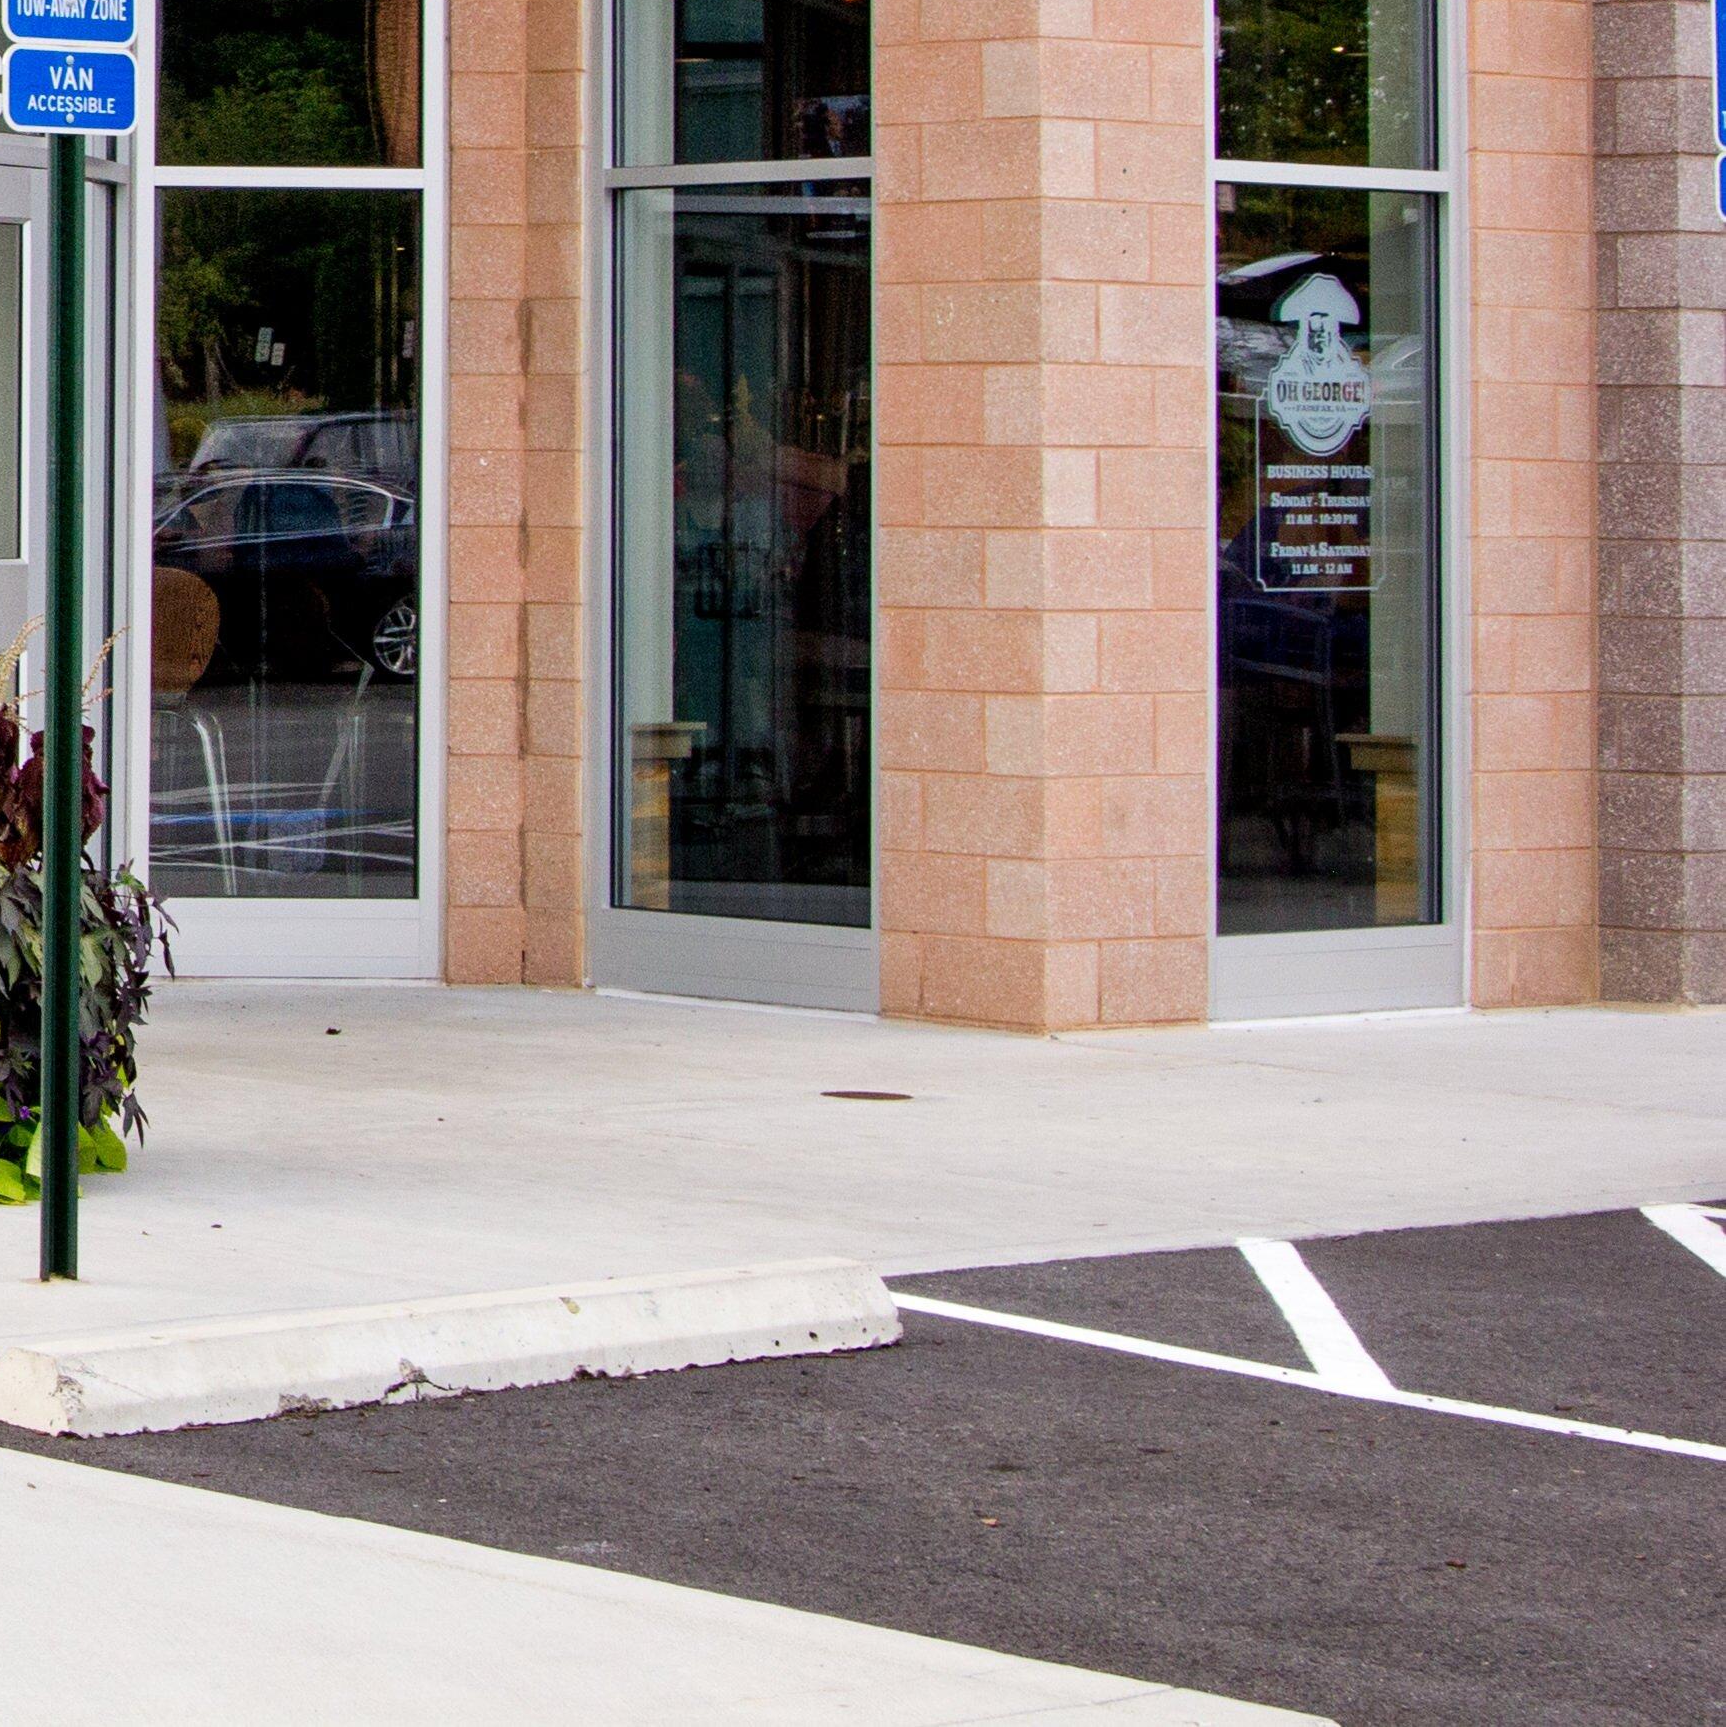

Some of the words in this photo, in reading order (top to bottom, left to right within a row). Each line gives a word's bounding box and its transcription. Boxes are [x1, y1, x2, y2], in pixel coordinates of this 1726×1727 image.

[49, 67, 93, 91] VAN
[27, 95, 116, 114] ACCESSIBLE
[1277, 379, 1299, 402] OH
[1302, 381, 1365, 404] GEORGE!
[1267, 465, 1328, 479] BUSINESS
[1270, 492, 1313, 507] SUNDAY
[1270, 542, 1308, 557] FRIDAY
